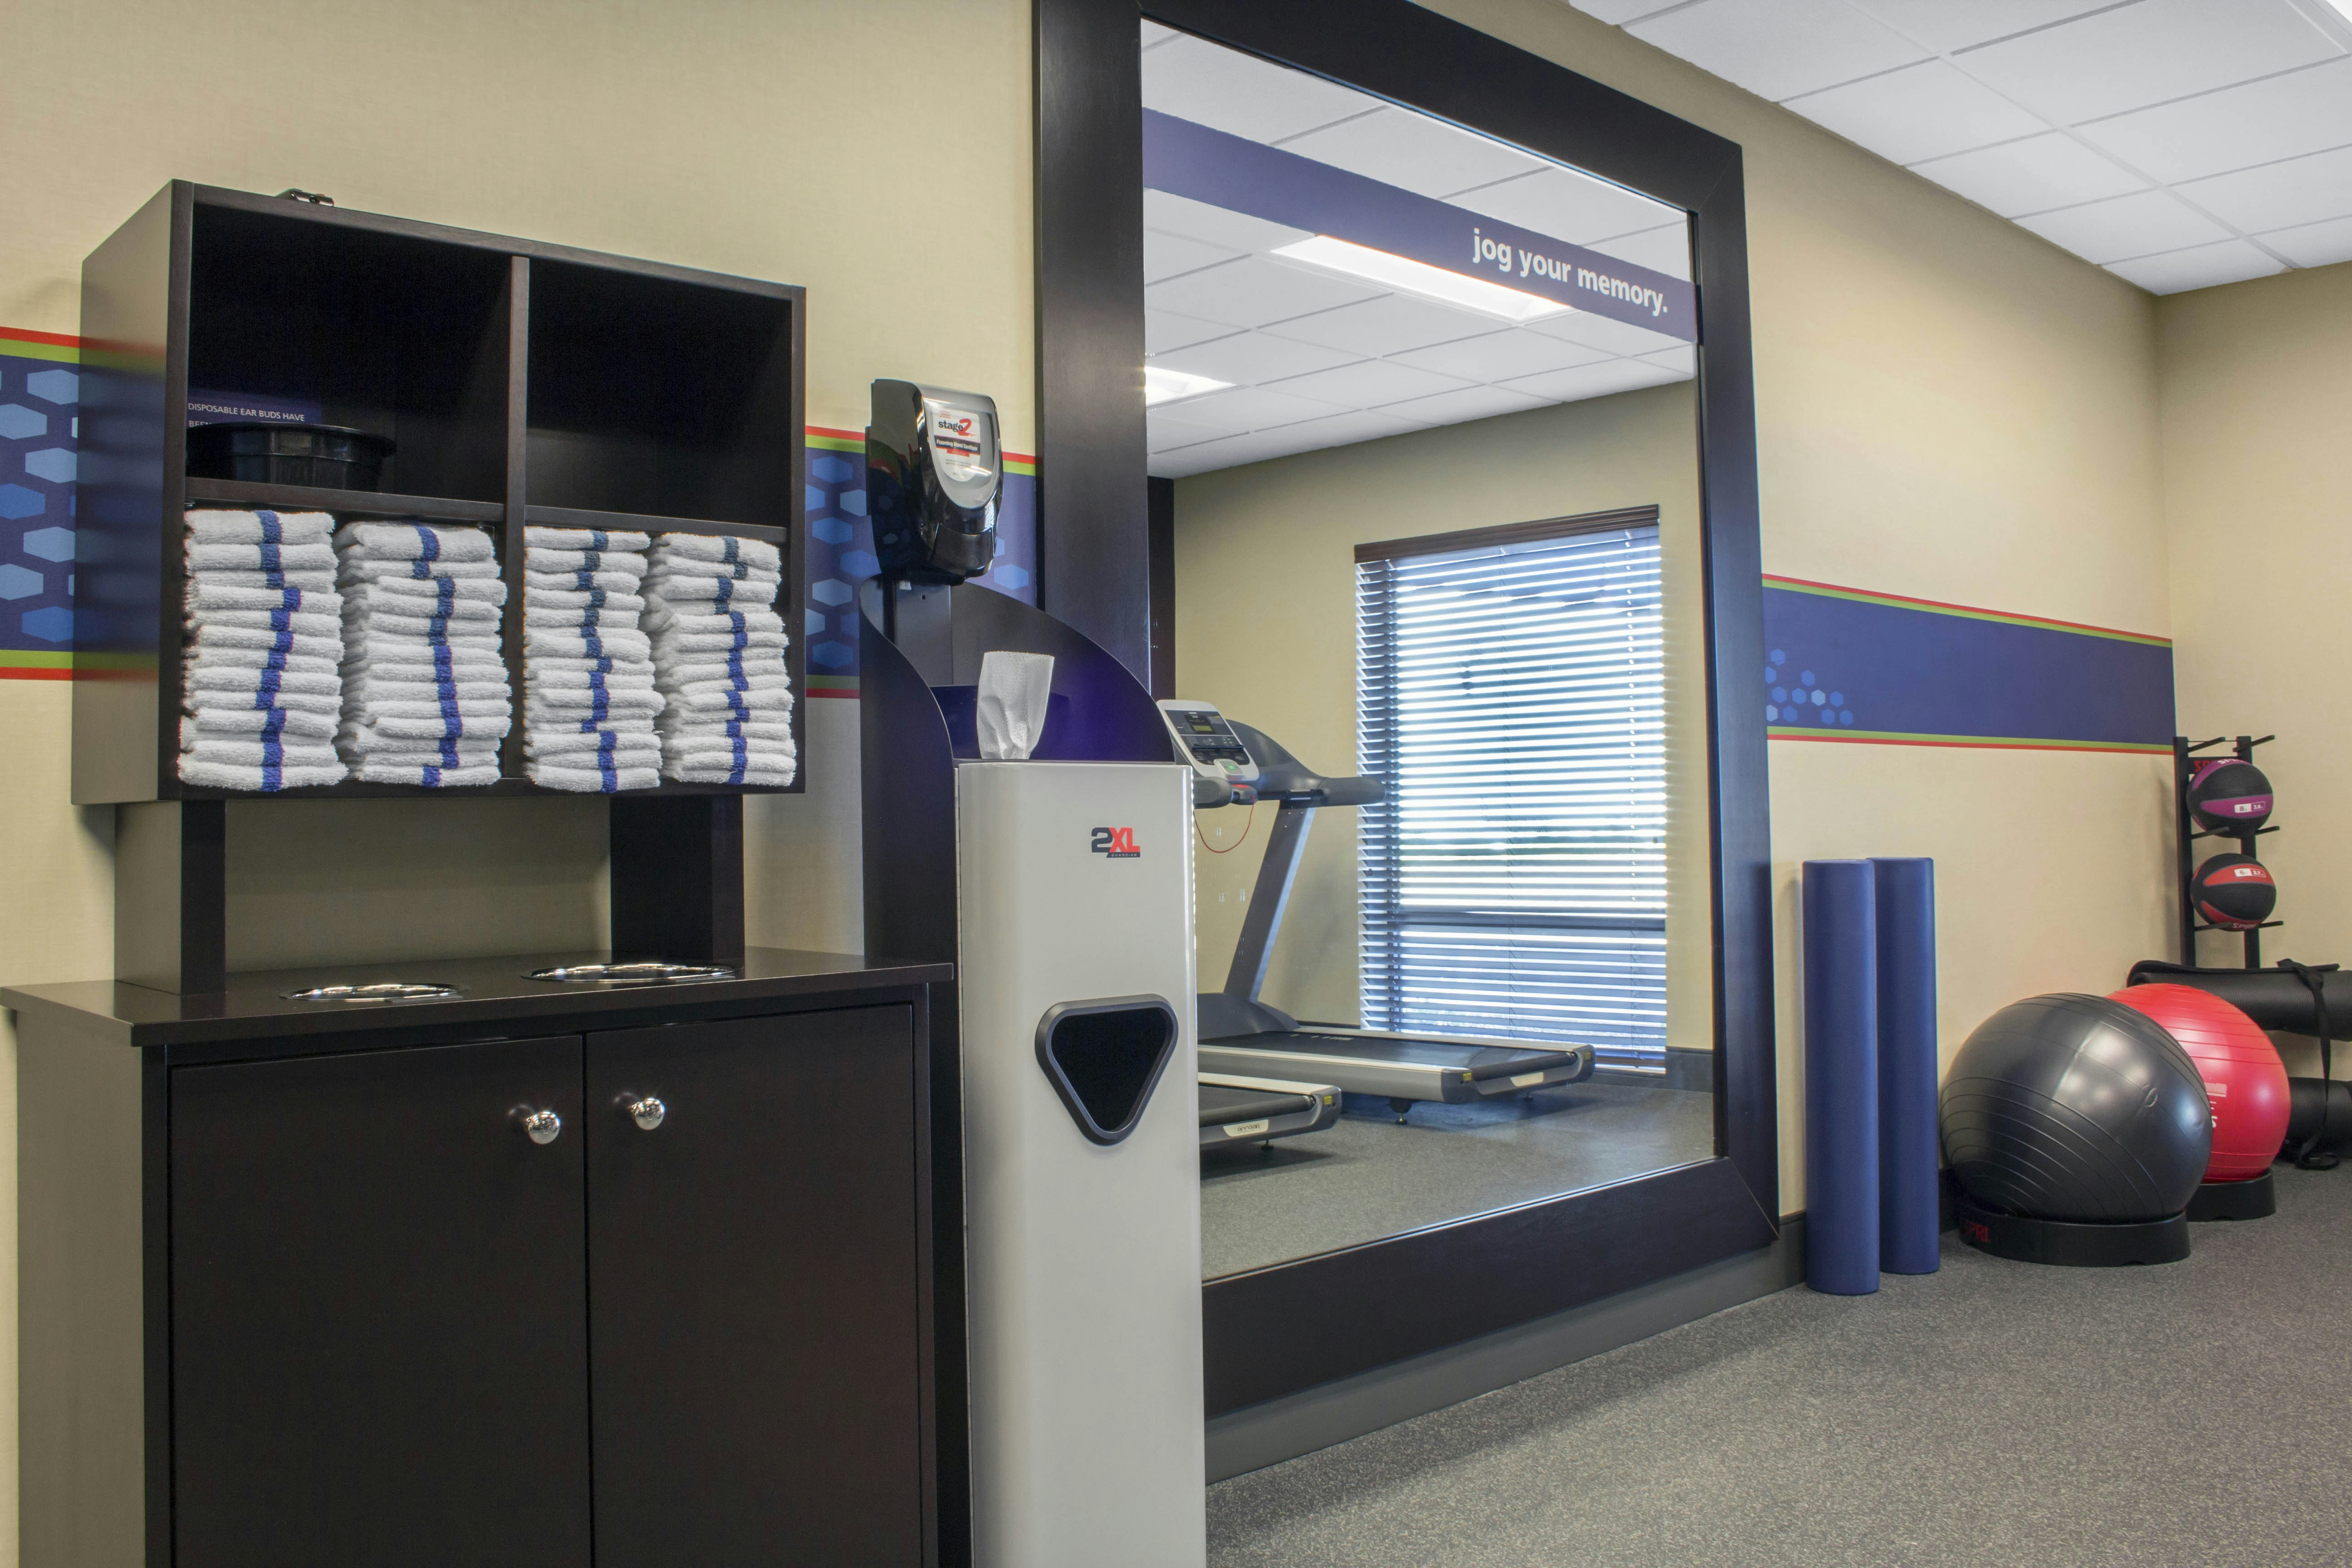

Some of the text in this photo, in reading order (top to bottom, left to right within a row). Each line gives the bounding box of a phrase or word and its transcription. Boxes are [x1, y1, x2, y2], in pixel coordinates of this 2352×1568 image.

[1473, 227, 1668, 317] jog your memory.
[188, 402, 305, 421] DISPOSABLE EAR BUDS HAVE
[1091, 827, 1140, 853] 2XL
